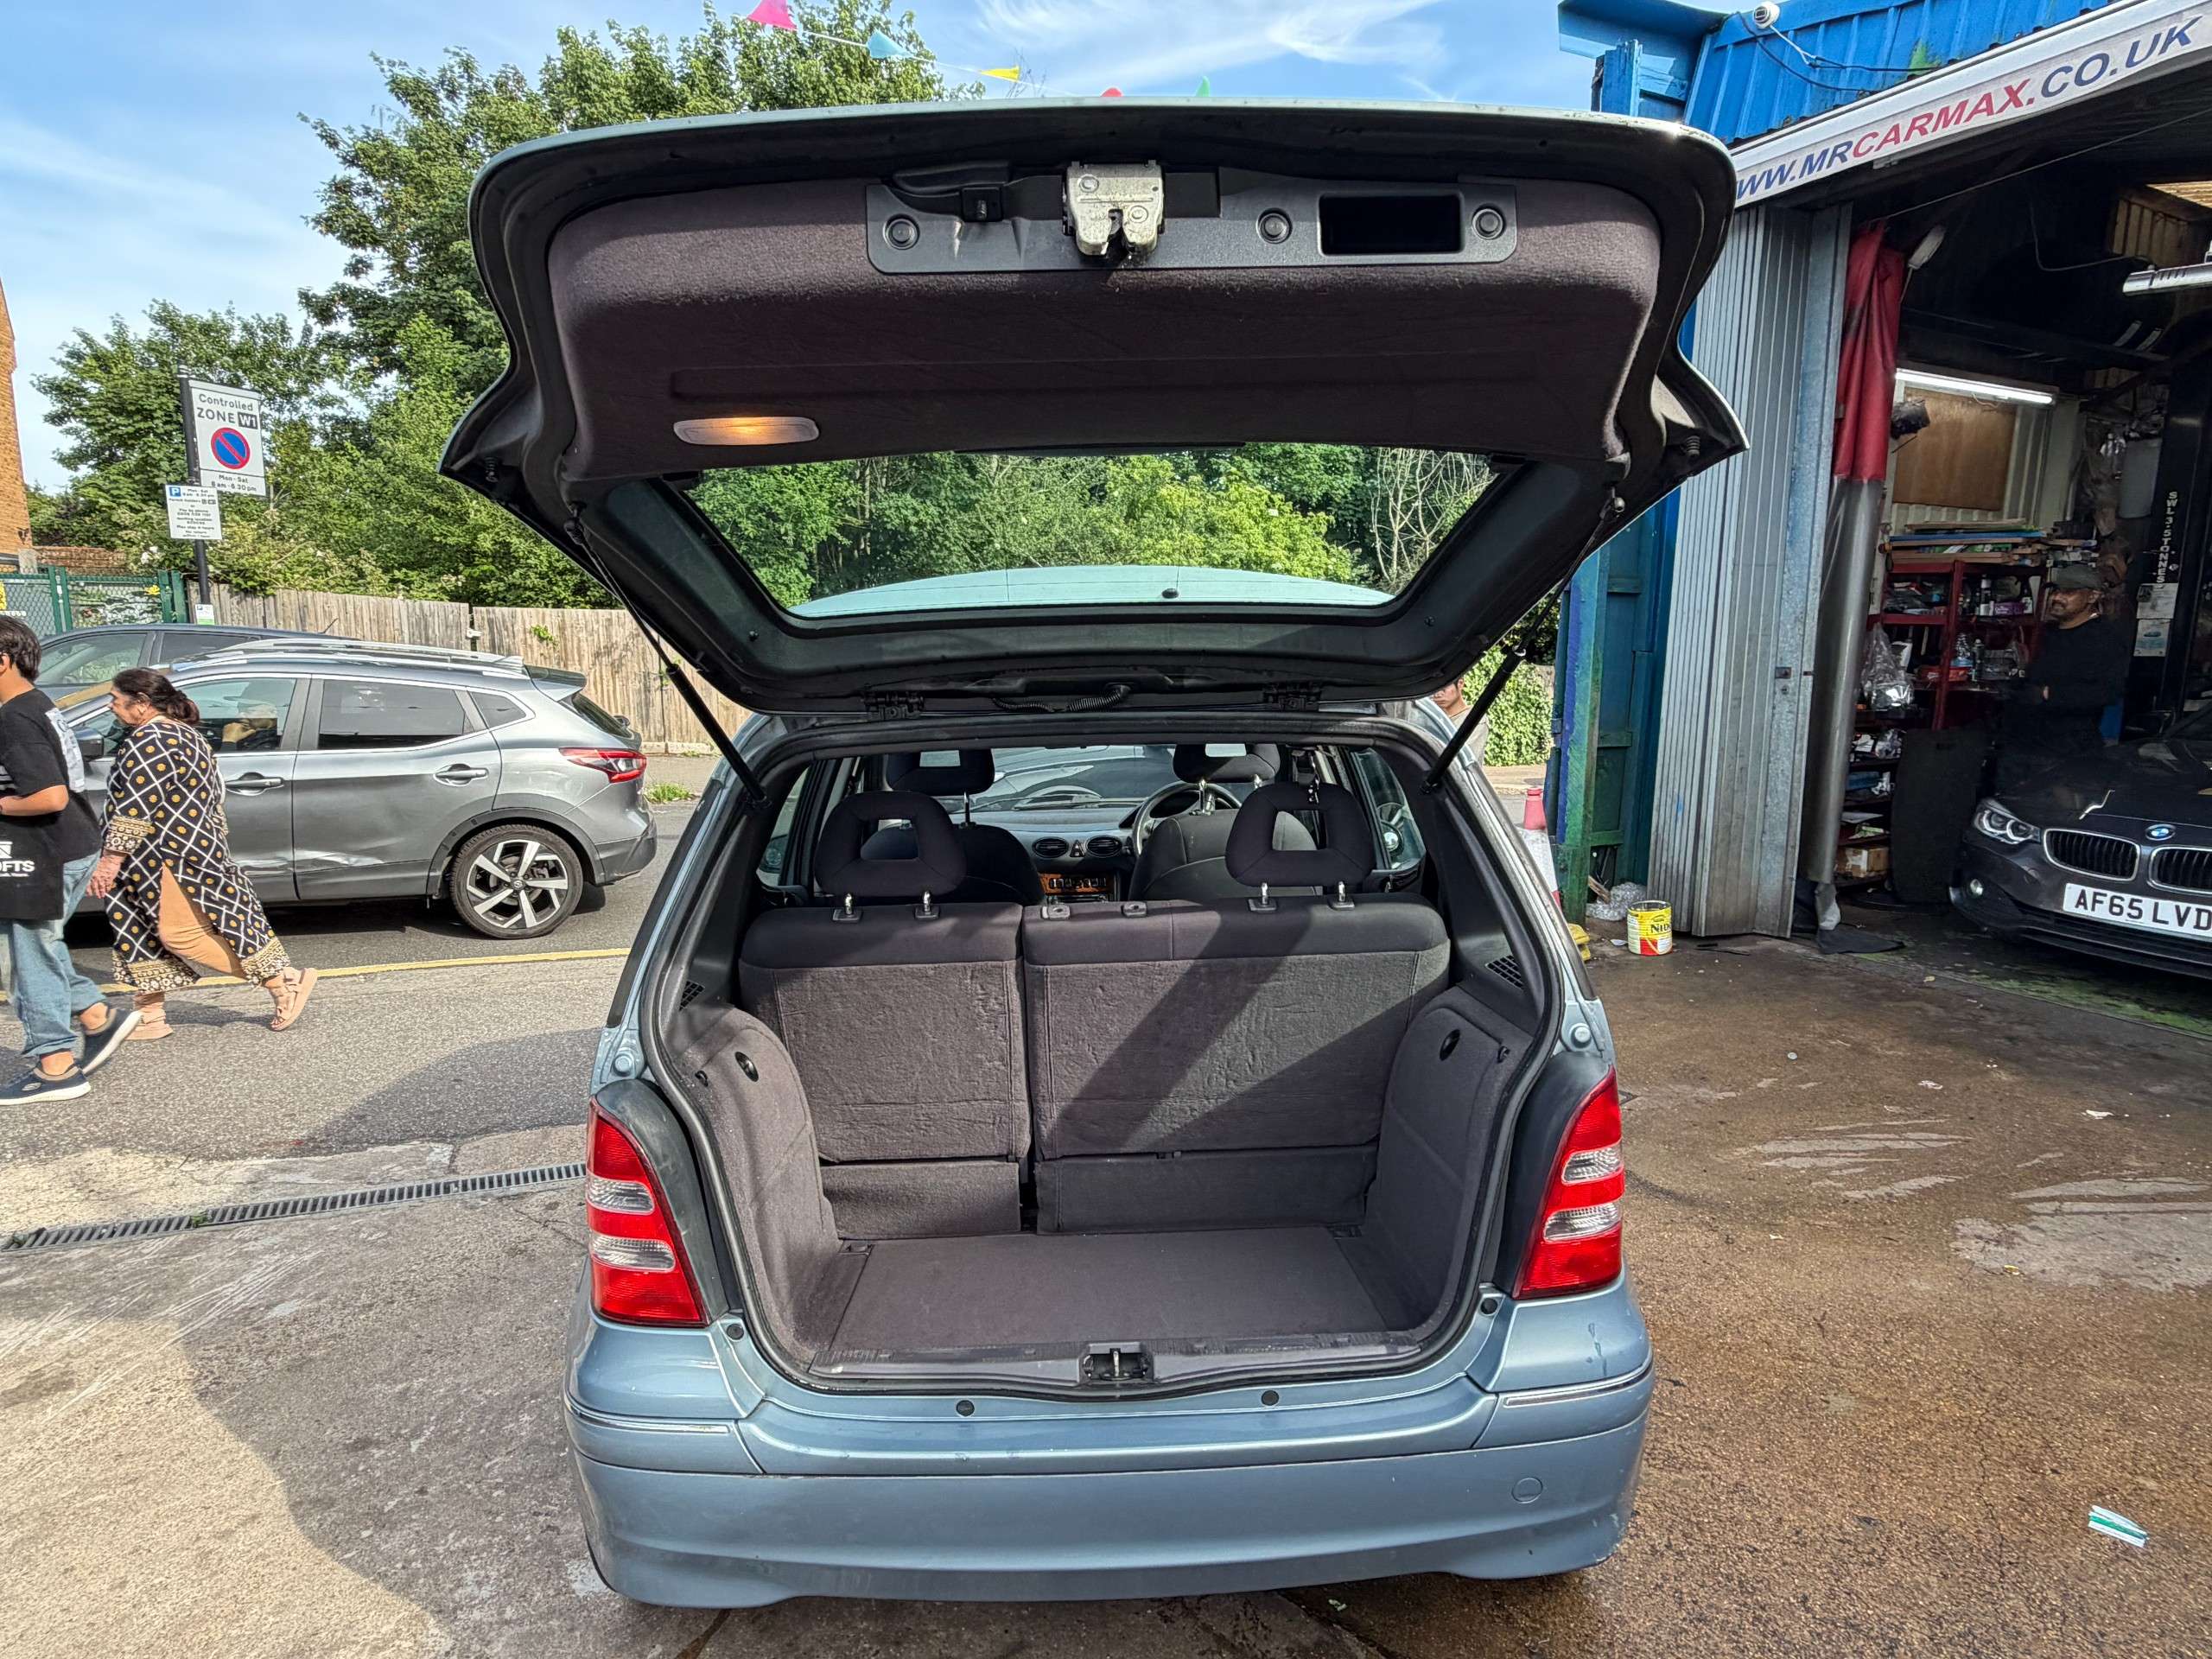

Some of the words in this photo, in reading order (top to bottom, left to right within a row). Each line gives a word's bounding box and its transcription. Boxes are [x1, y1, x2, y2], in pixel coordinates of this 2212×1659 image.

[1737, 16, 2203, 200] WW.MRCARMAX.CO.UK
[199, 393, 253, 411] Controlled
[196, 407, 236, 423] ZONE
[238, 413, 257, 428] W1
[0, 860, 35, 872] FTS
[2075, 888, 2143, 920] AF65
[2152, 901, 2212, 931] LVD
